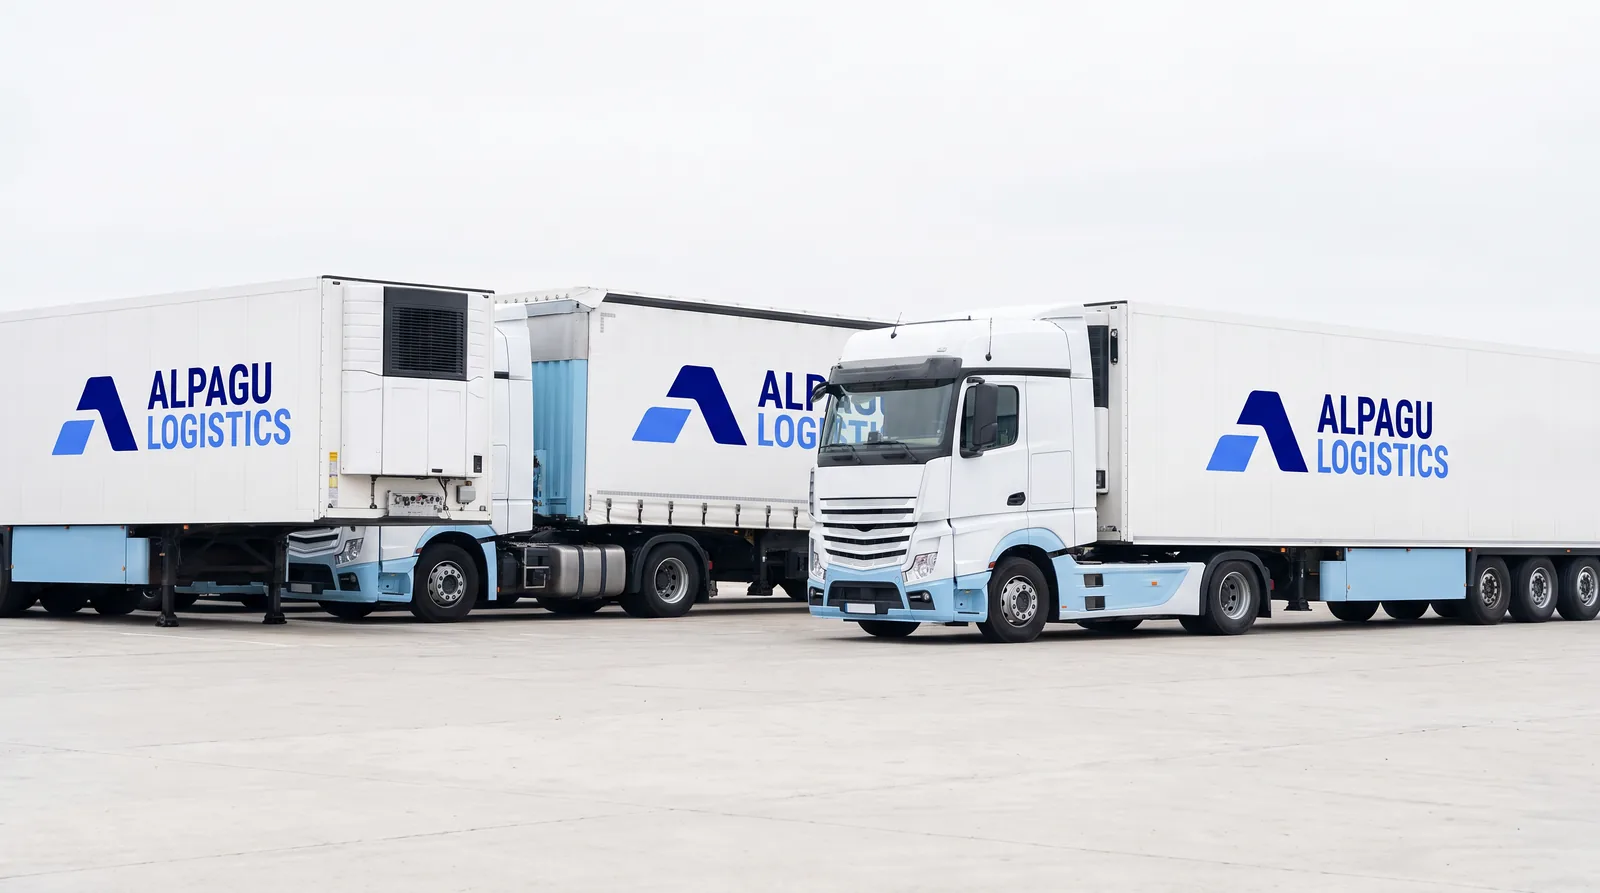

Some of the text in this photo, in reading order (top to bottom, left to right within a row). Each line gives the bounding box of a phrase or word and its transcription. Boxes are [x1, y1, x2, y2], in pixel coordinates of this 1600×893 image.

[148, 362, 272, 409] ALPAGU
[758, 370, 885, 417] ALP
[147, 408, 292, 450] LOGISTICS
[757, 412, 885, 450] LOGST
[1317, 394, 1433, 439] ALPAGU
[1317, 438, 1449, 478] LOGISTICS
